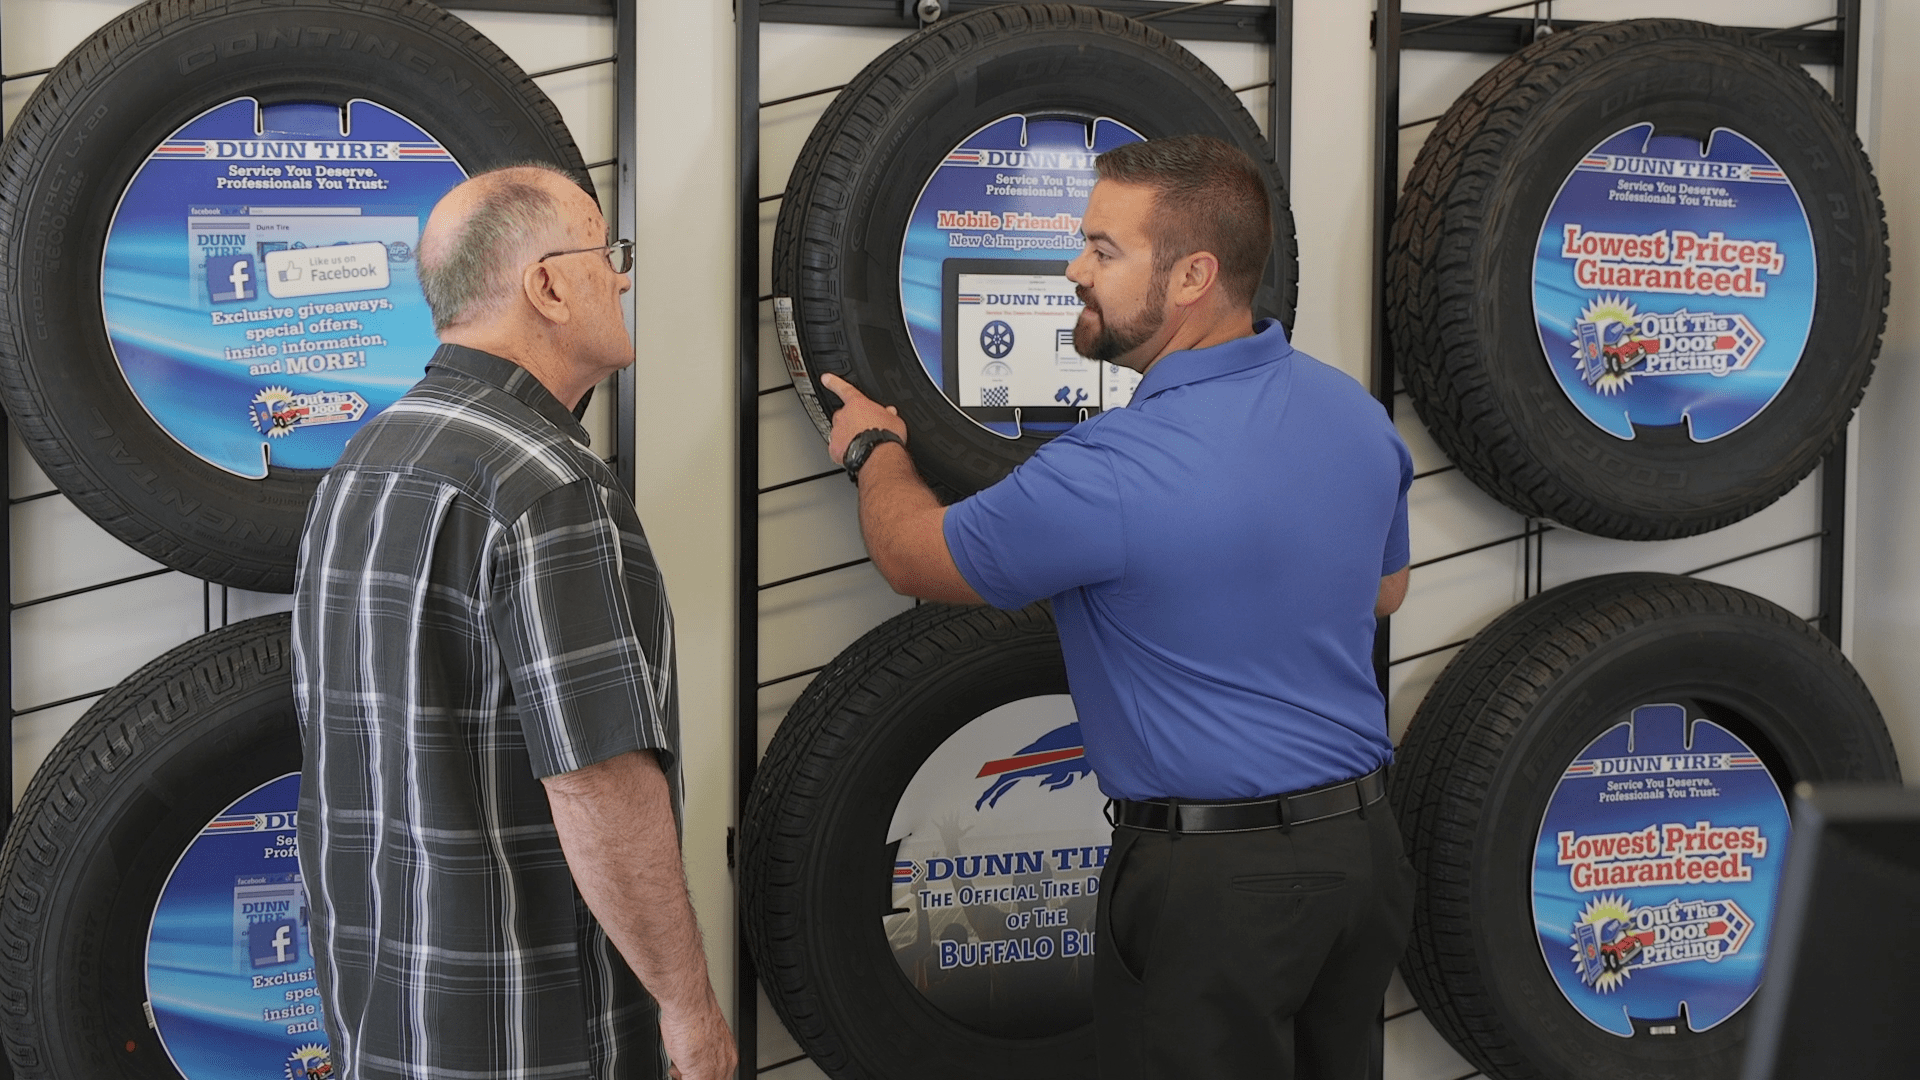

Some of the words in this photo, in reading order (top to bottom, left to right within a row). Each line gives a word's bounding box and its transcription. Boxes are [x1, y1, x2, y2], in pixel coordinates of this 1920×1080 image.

[216, 141, 306, 158] DUNN
[315, 142, 389, 159] TIRE
[987, 151, 1059, 168] DUNN
[1613, 157, 1674, 174] DUNN
[1680, 162, 1742, 179] TIRE
[228, 164, 281, 177] Service
[285, 164, 312, 177] You
[315, 164, 377, 177] Deserve.
[216, 177, 312, 189] Professionals
[316, 177, 343, 189] You
[995, 173, 1039, 186] Service
[1041, 174, 1064, 187] You
[1617, 178, 1654, 192] Service
[1656, 181, 1677, 194] You
[1679, 182, 1729, 197] Deserve.
[986, 184, 1063, 197] Professionals
[1067, 187, 1089, 198] You
[1608, 189, 1676, 205] Professionals
[1679, 194, 1700, 206] You
[191, 207, 221, 216] facebook
[256, 223, 274, 232] Dunn
[276, 223, 290, 231] Tire
[938, 212, 1000, 229] Mobile
[1005, 214, 1081, 234] Friendly
[197, 234, 246, 246] DUNN
[951, 234, 980, 247] New
[984, 235, 994, 247] &
[998, 236, 1062, 249] Improved
[202, 246, 242, 258] TIRE
[1564, 228, 1666, 260] Lowest
[1675, 235, 1781, 271] Prices,
[309, 257, 330, 267] Like
[331, 257, 342, 266] us
[346, 255, 357, 264] on
[311, 265, 377, 282] Facebook
[1577, 258, 1762, 293] Guaranteed.
[986, 294, 1040, 305] DUNN
[211, 306, 294, 325] Exclusive
[298, 298, 393, 318] giveaways,
[246, 322, 305, 341] special
[309, 318, 364, 333] offers,
[1641, 314, 1688, 337] Out
[1690, 317, 1729, 332] The
[225, 344, 278, 360] inside
[282, 334, 388, 354] information,
[1659, 333, 1716, 353] Door
[249, 360, 281, 376] and
[286, 351, 366, 374] MORE!
[1645, 352, 1730, 373] Pricing
[297, 394, 325, 405] Out
[1600, 756, 1662, 774] DUNN
[1667, 755, 1722, 771] TIRE
[1607, 779, 1643, 791] Service
[1645, 778, 1664, 789] You
[1666, 777, 1713, 787] Deserve.
[1599, 789, 1664, 802] Professionals
[1667, 789, 1686, 798] You
[1561, 831, 1656, 861] Lowest
[1665, 825, 1763, 853] Prices,
[926, 851, 1044, 881] DUNN
[1573, 853, 1748, 888] Guaranteed.
[238, 877, 266, 885] facebook
[920, 891, 952, 908] THE
[960, 884, 1037, 904] OFFICIAL
[1043, 880, 1080, 898] TIRE
[242, 901, 289, 914] DUNN
[1035, 908, 1067, 926] THE
[1636, 904, 1680, 931] Out
[1684, 904, 1719, 920] The
[1654, 921, 1709, 944] Door
[941, 938, 1053, 967] BUFFALO
[1642, 940, 1721, 965] Pricing
[252, 968, 316, 988] Exclusi
[264, 1003, 315, 1021] inside
[287, 1018, 318, 1035] and
